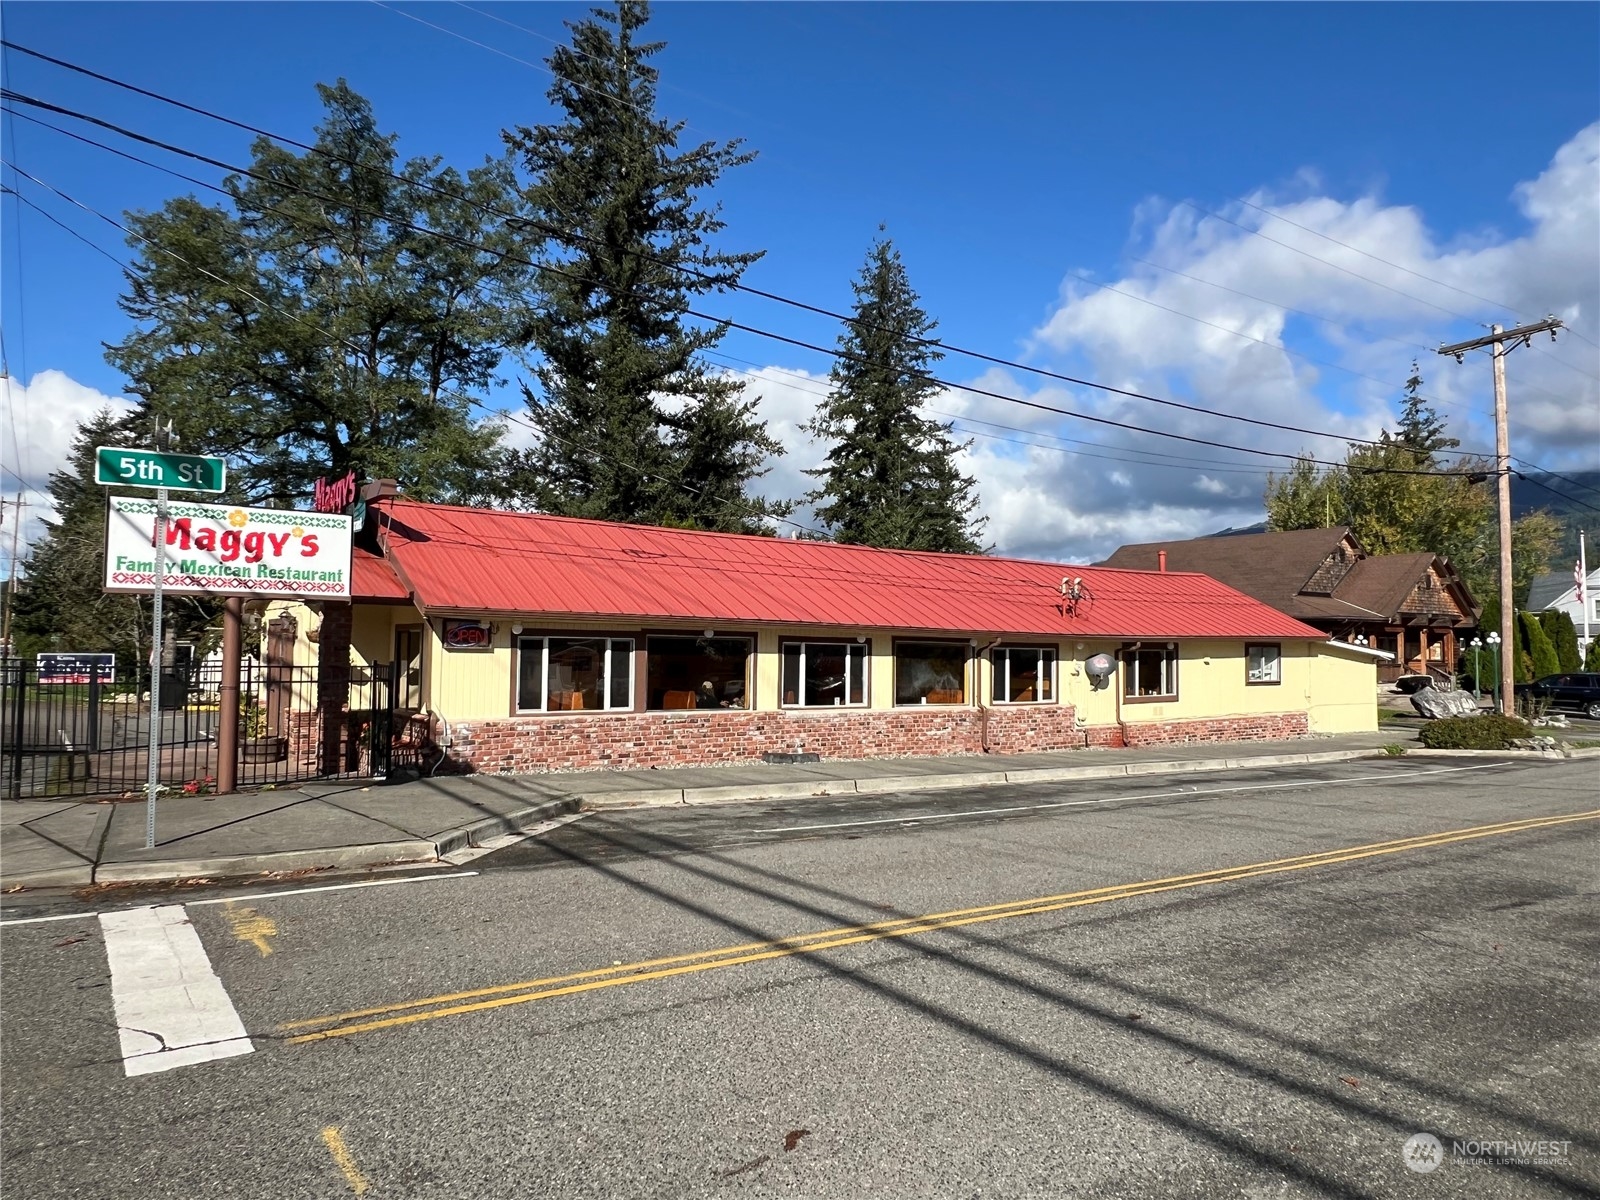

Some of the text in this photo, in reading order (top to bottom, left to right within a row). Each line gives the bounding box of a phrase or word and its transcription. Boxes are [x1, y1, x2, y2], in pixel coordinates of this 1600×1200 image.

[120, 457, 204, 484] 5th St
[152, 516, 320, 564] Maggy's
[116, 555, 343, 582] Famy Mexican Restaurant
[448, 628, 487, 643] OPEN
